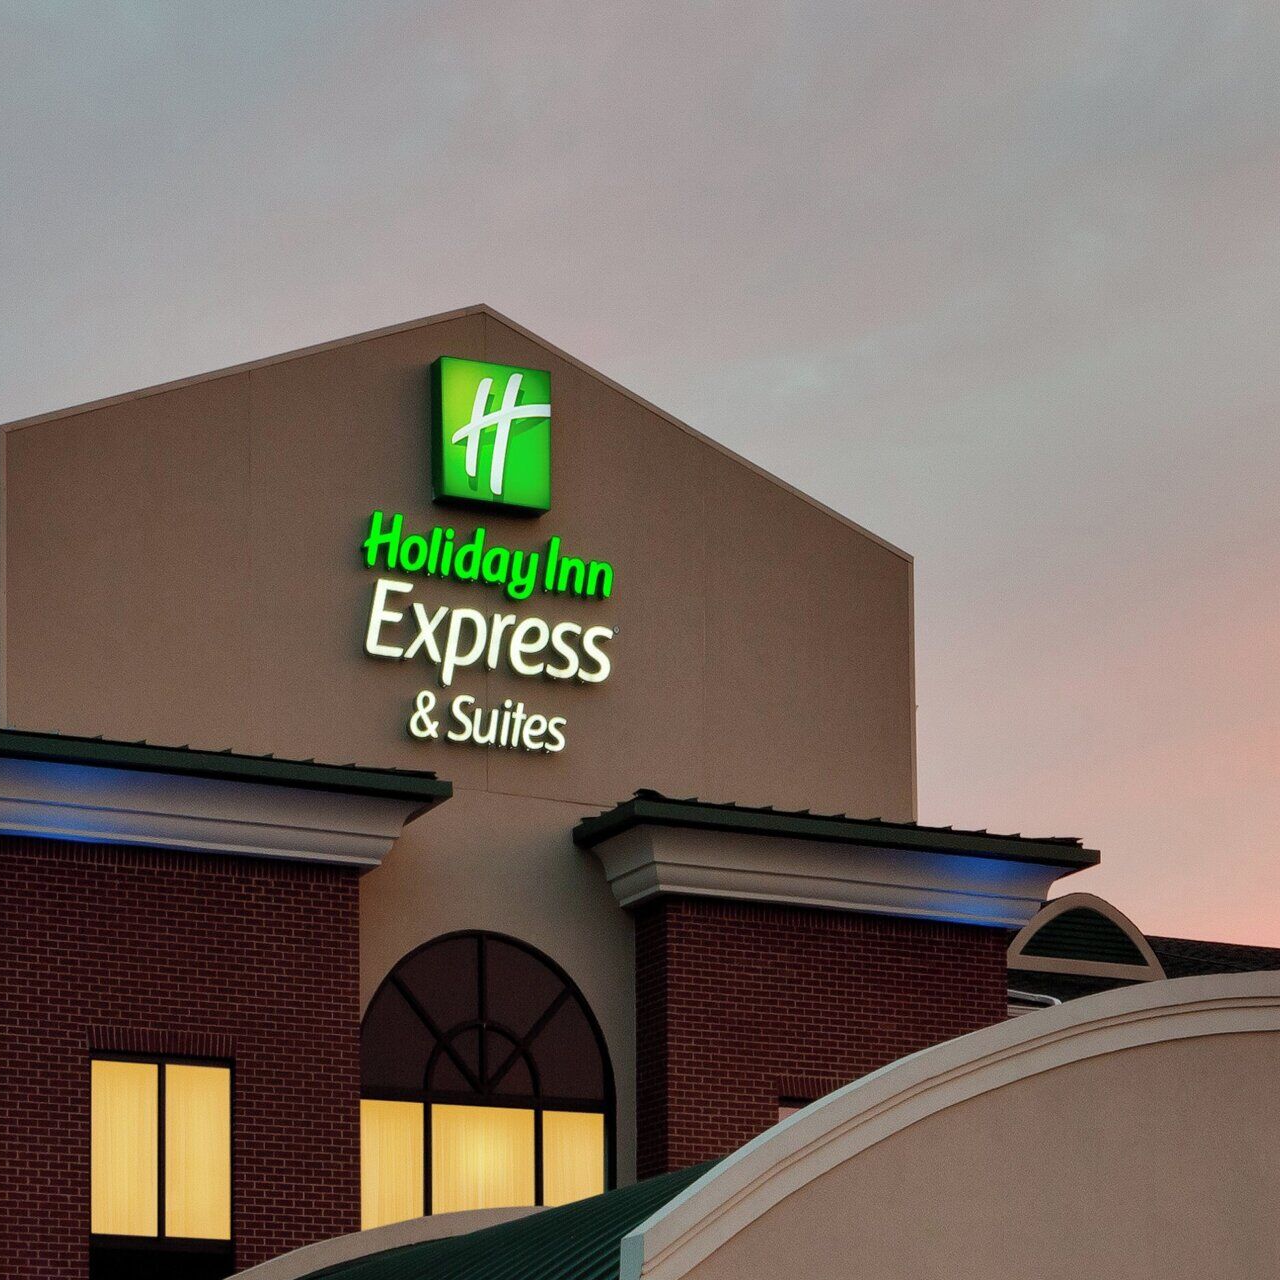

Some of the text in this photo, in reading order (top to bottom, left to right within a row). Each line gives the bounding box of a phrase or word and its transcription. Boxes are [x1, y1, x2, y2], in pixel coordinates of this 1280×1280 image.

[363, 511, 614, 600] Holiday Inn
[365, 578, 614, 686] Express
[409, 690, 568, 752] & Suites
